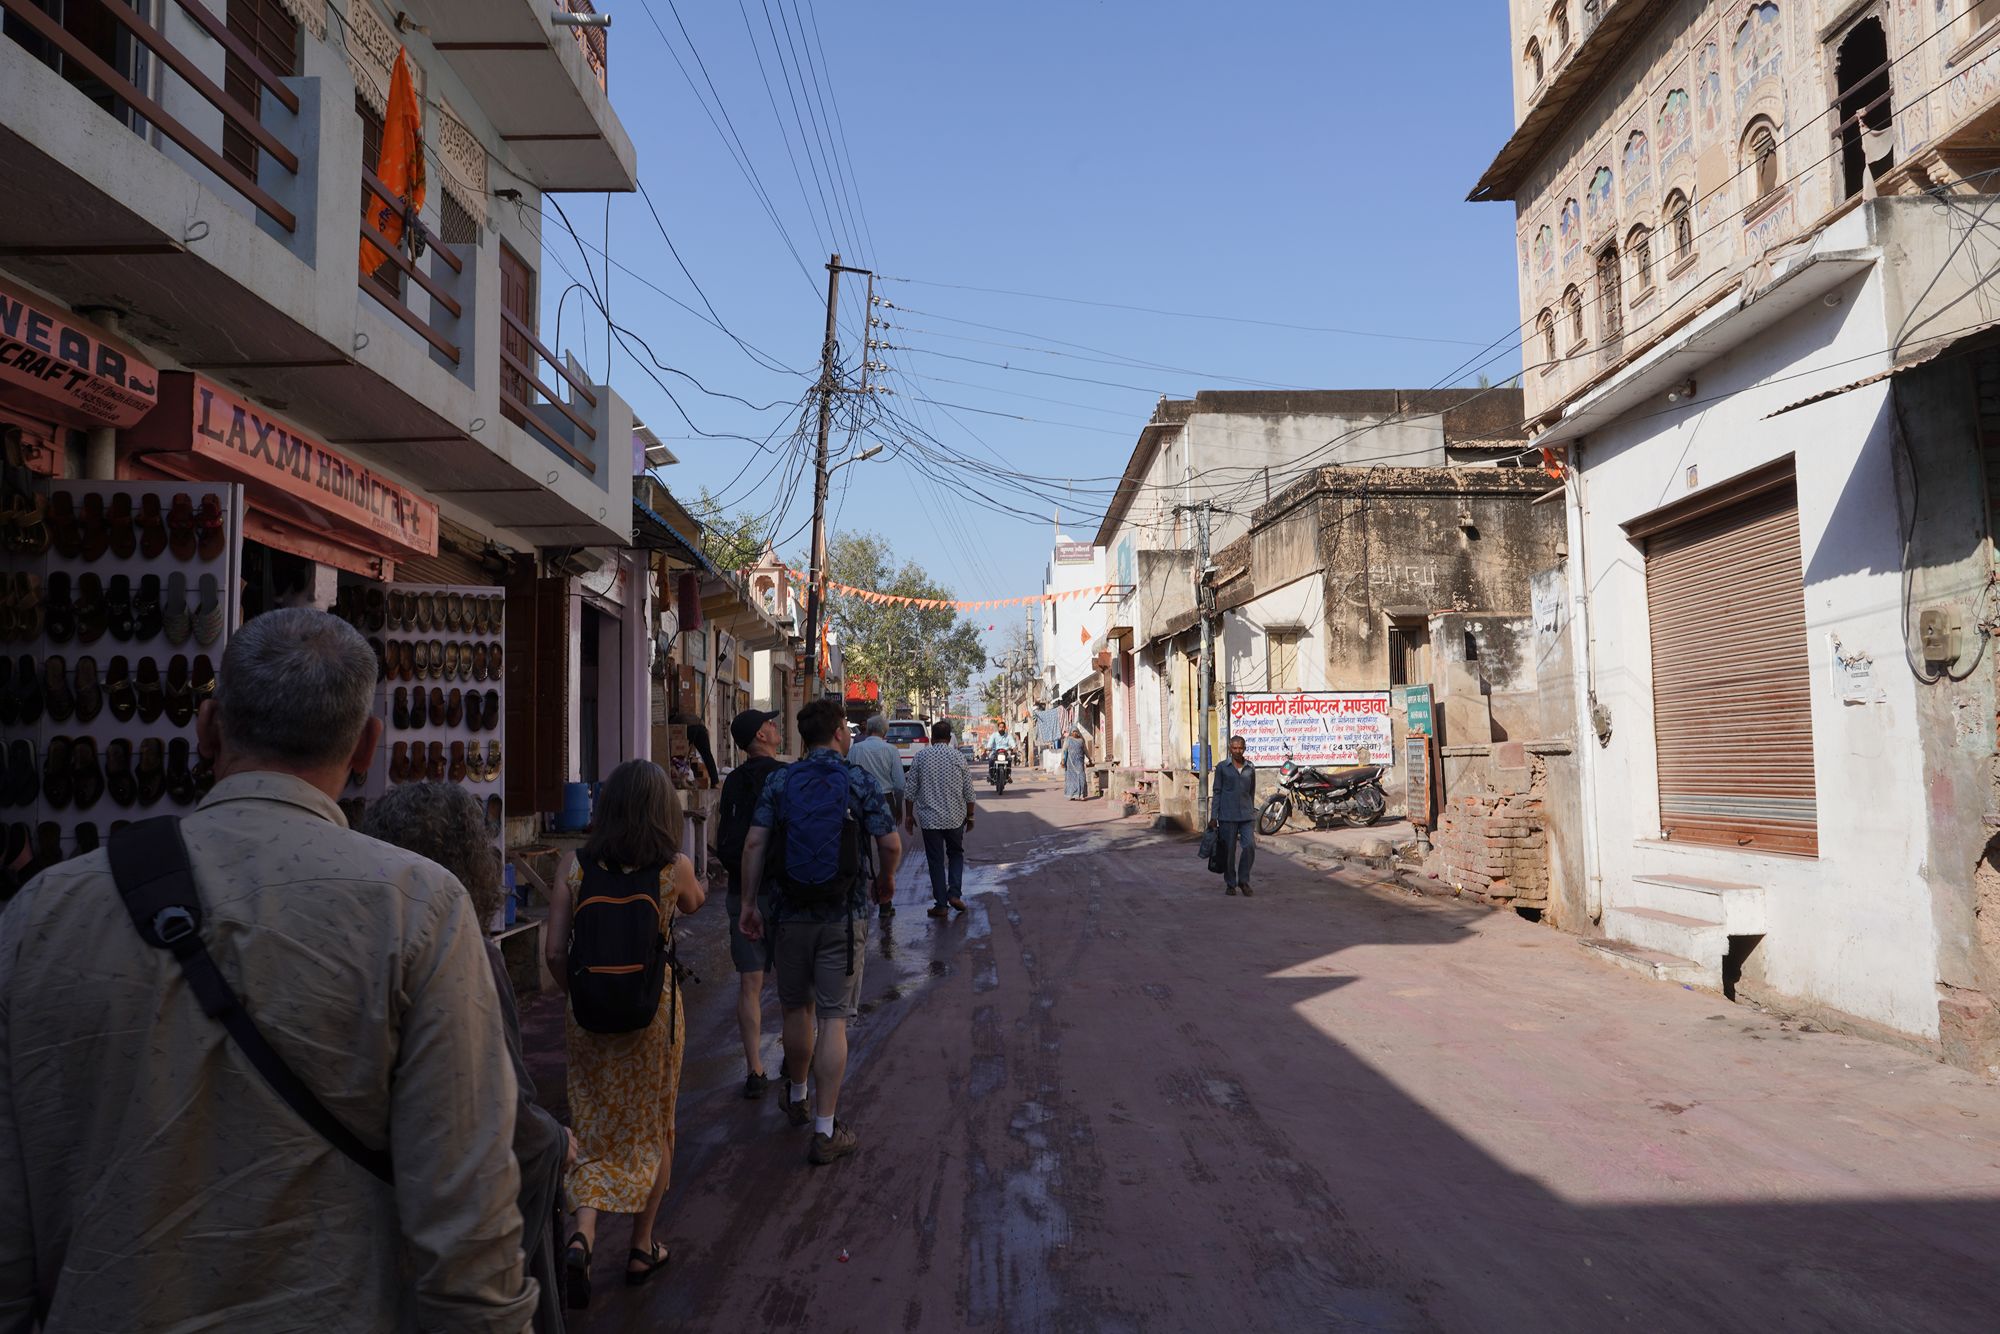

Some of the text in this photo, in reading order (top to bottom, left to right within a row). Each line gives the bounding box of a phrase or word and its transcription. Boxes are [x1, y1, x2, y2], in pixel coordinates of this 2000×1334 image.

[198, 387, 312, 482] LAXMI
[1232, 695, 1286, 719] शेखावाटी
[1343, 699, 1387, 716] मण्डावा
